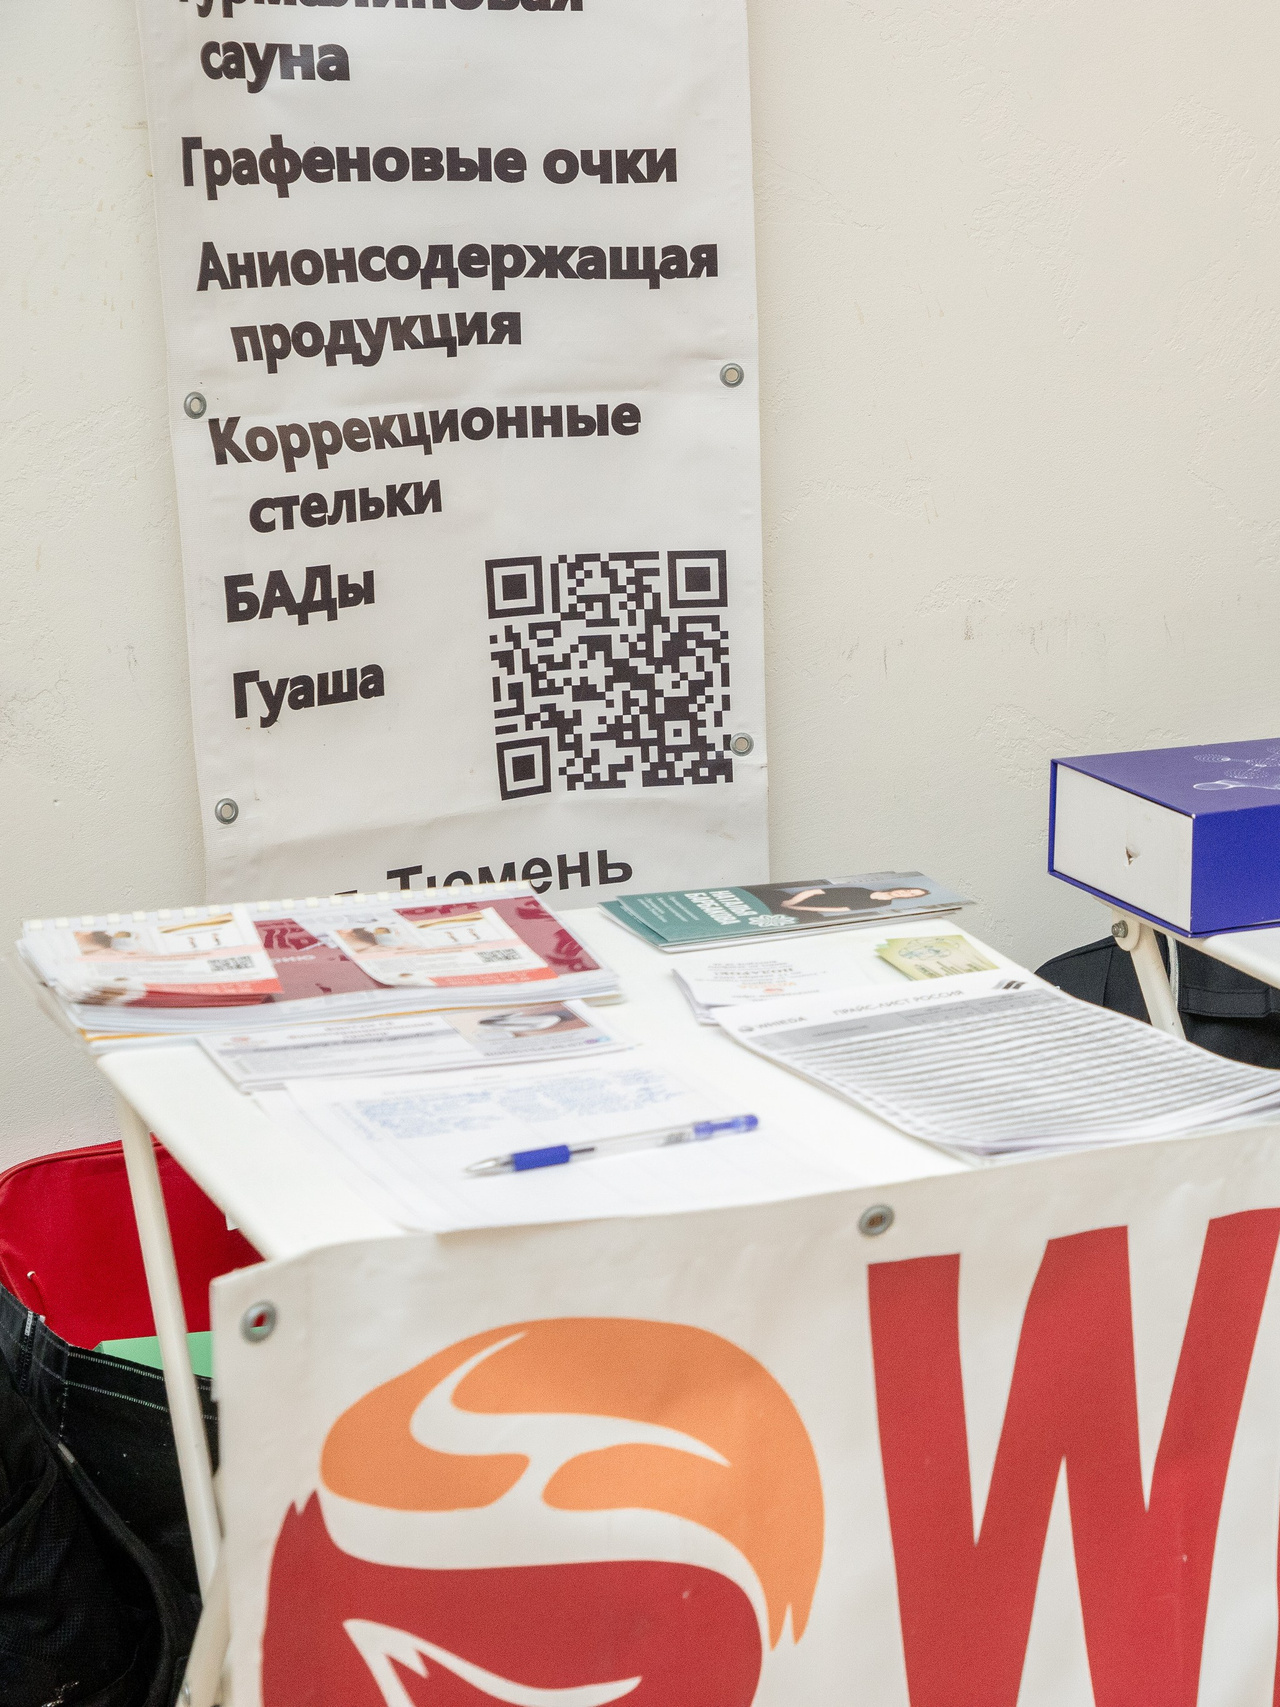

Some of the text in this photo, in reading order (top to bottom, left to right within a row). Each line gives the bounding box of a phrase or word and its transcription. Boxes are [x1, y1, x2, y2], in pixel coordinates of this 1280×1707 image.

[200, 41, 351, 94] сауна
[181, 135, 678, 201] Графеновые очки
[197, 241, 719, 292] Анионсодержащая
[230, 311, 522, 375] продукция
[208, 398, 642, 471] Коррекционные
[249, 479, 443, 534] стельки
[224, 564, 376, 626] БАДы
[232, 663, 385, 729] Гуаша
[832, 990, 964, 1016] ПРАЙС-ЛИСТ РОССИЯ
